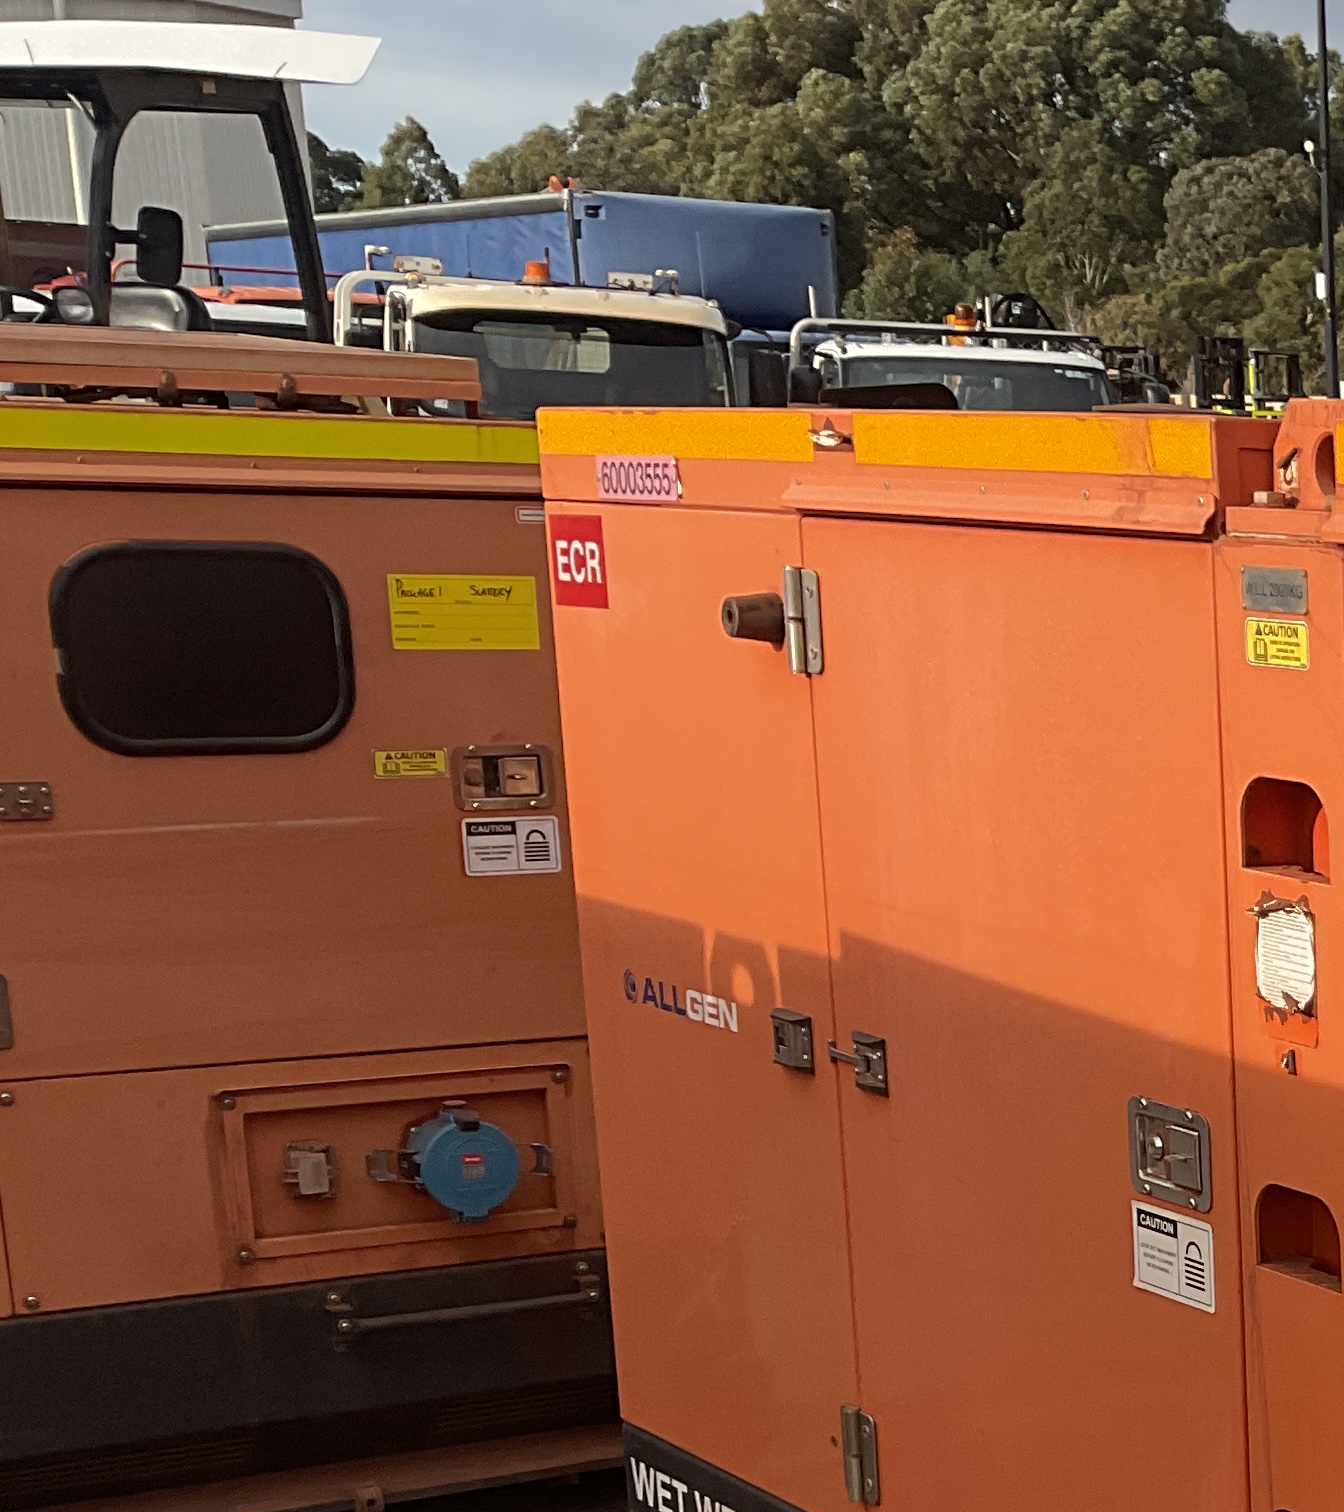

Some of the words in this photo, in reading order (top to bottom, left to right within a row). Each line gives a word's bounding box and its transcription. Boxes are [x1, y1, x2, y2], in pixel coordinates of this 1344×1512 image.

[601, 461, 671, 496] 60003555
[555, 539, 602, 584] ECR
[1263, 623, 1299, 639] CAUTION
[394, 751, 436, 760] CAUTION
[470, 824, 512, 833] CAUTION
[641, 977, 739, 1033] ALLGEN
[1139, 1213, 1174, 1235] CAUTION
